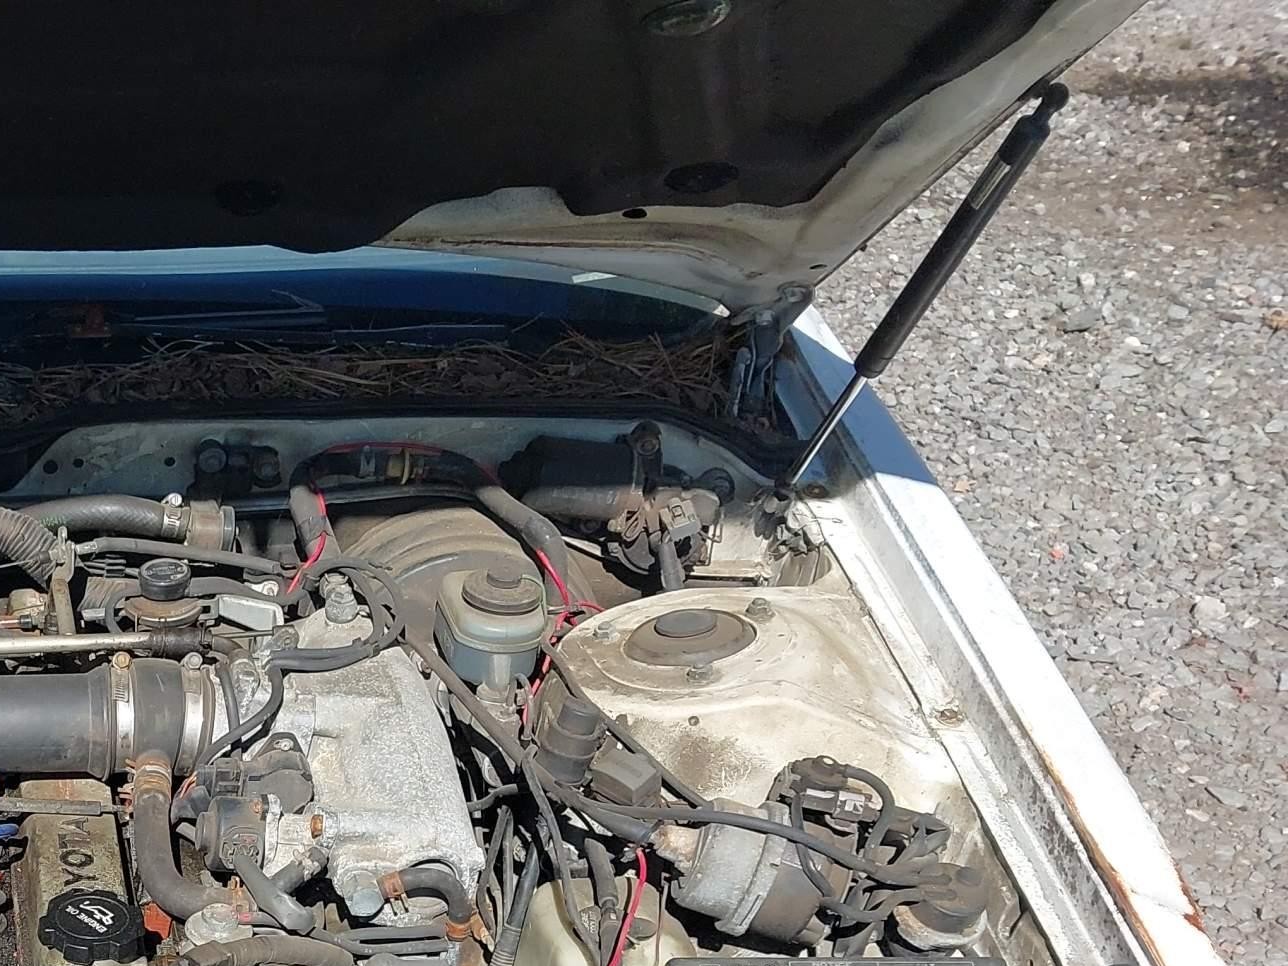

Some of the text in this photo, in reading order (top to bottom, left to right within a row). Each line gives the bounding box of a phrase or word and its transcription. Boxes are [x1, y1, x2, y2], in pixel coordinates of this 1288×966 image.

[57, 816, 99, 888] YOTA
[65, 905, 108, 933] ENGINE OIL
